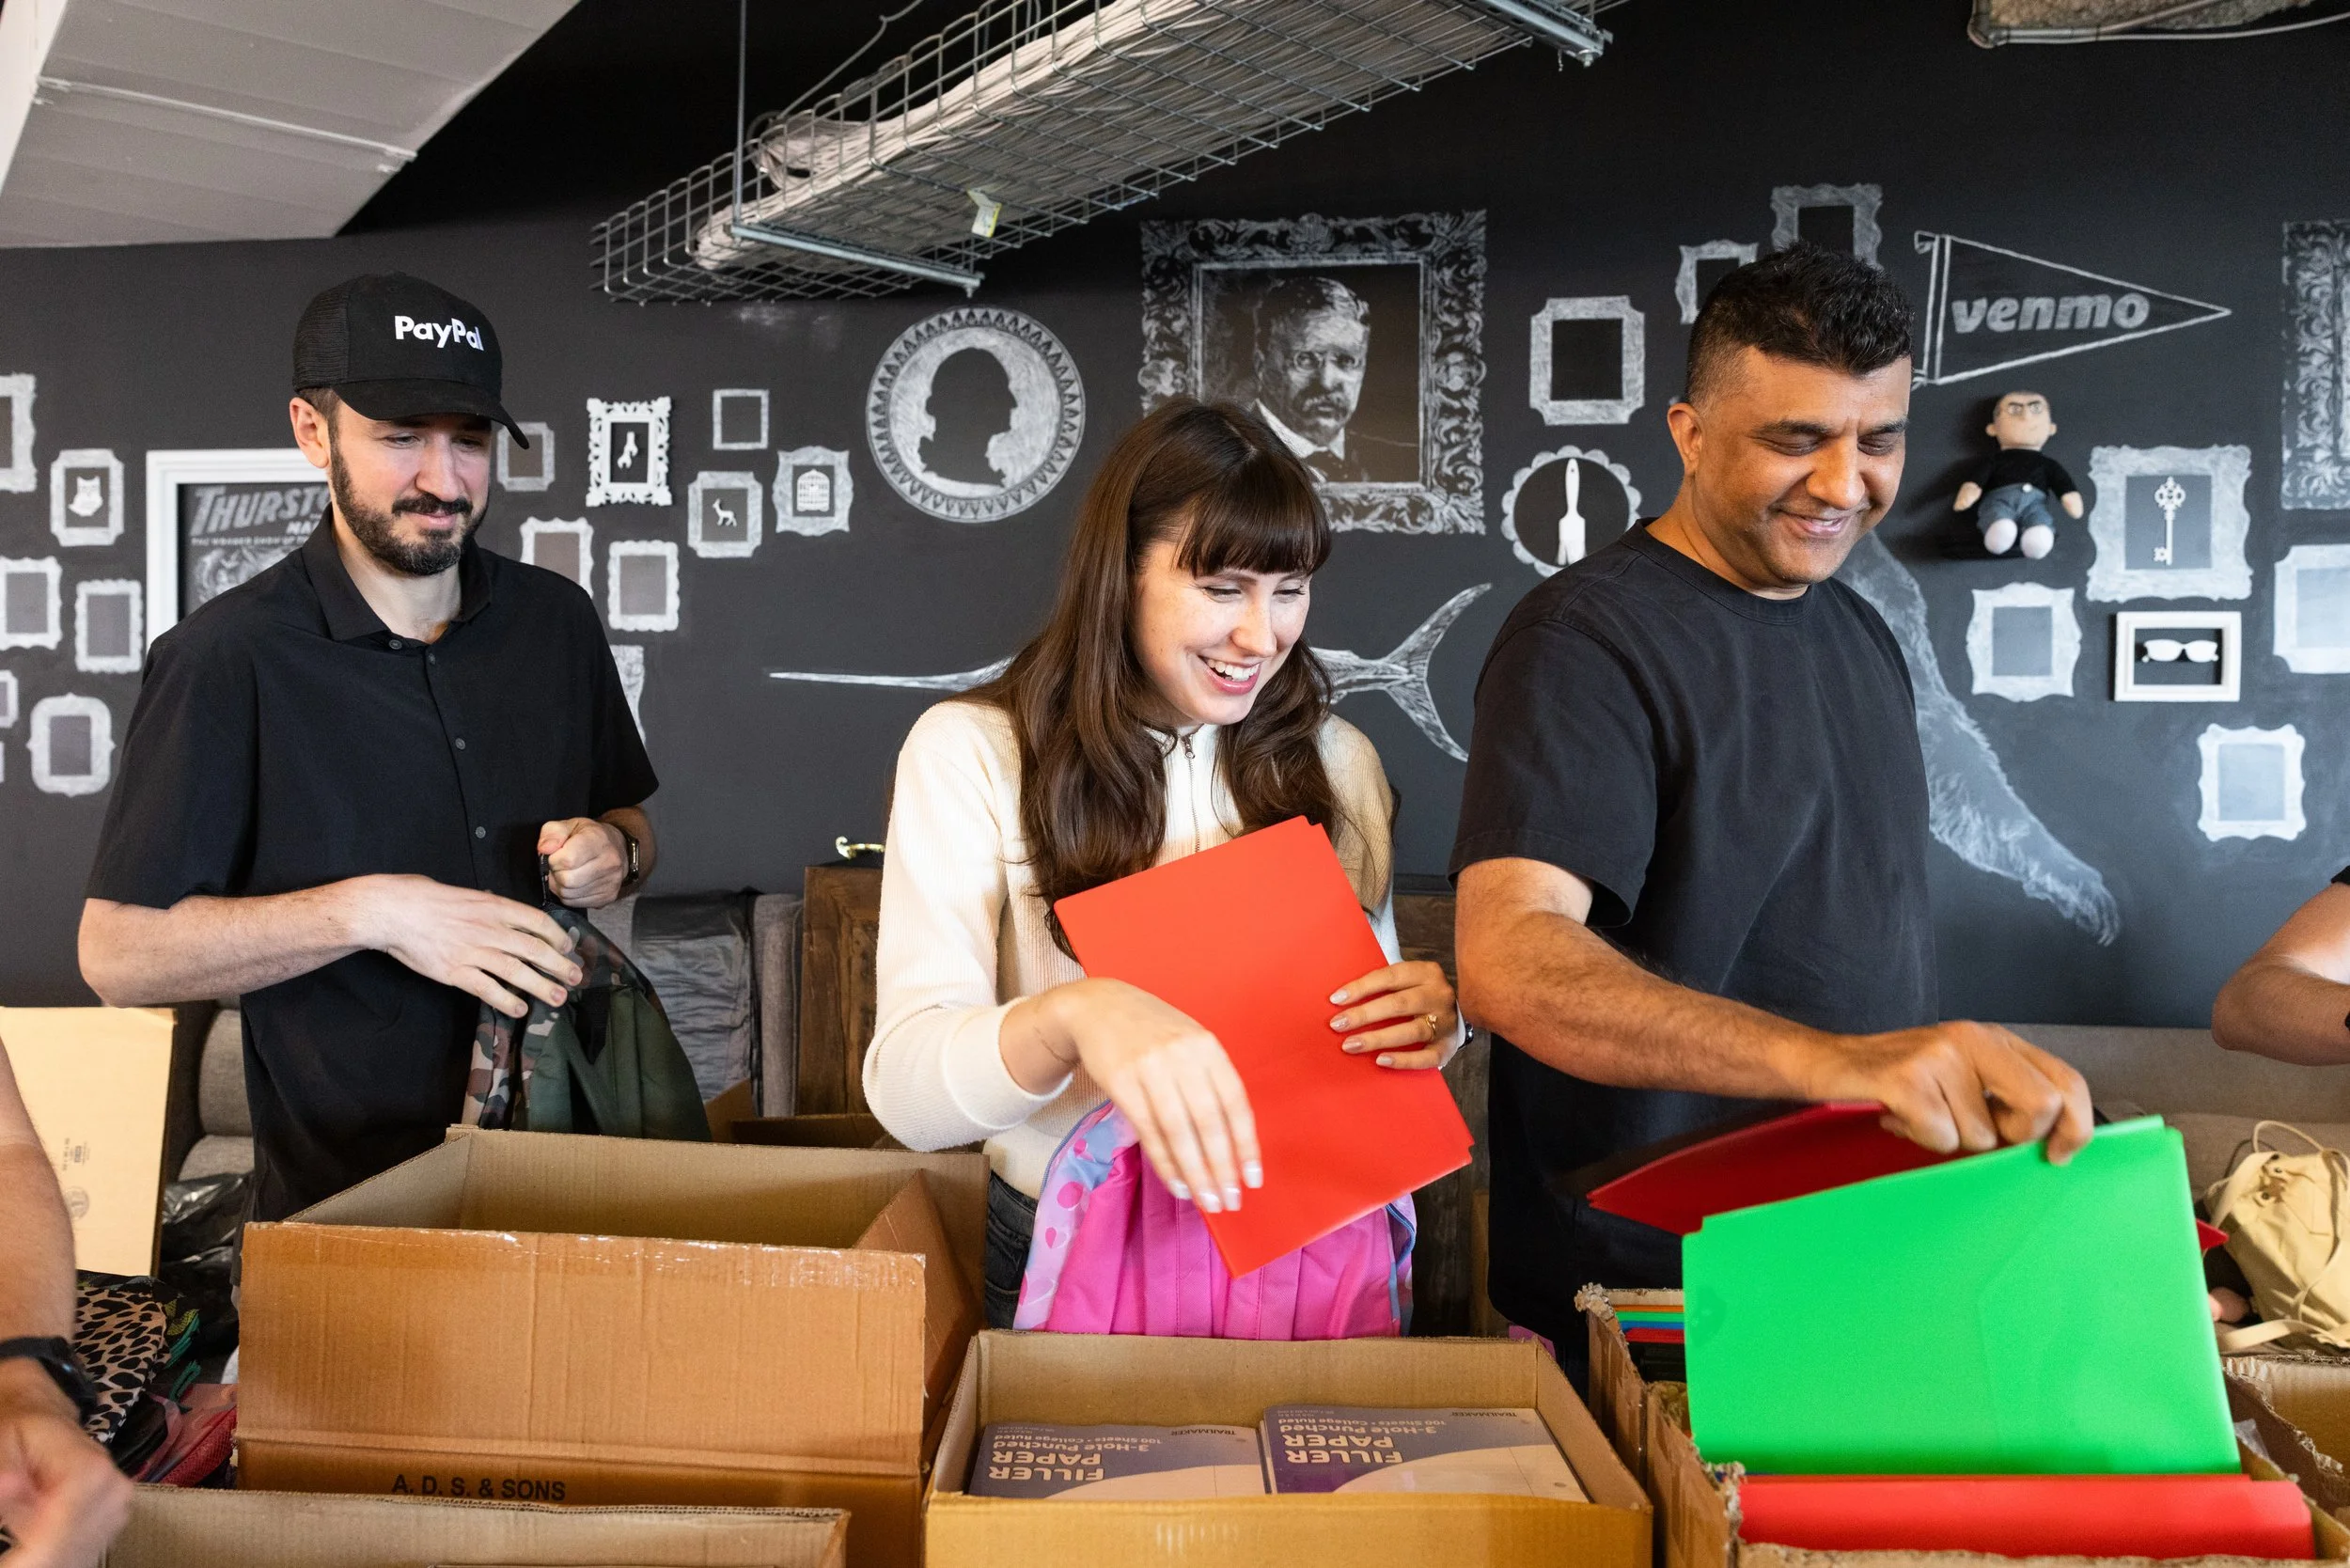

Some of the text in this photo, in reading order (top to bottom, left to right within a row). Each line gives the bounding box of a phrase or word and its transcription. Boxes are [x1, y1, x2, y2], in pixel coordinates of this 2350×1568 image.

[1951, 292, 2150, 334] venmo
[394, 315, 484, 351] PayPal
[1171, 1428, 1236, 1436] TRAILMAKER
[1279, 1424, 1437, 1435] 3-Hole Punched
[994, 1441, 1150, 1451] 3-Hole Punched
[1282, 1435, 1394, 1448] PAPER
[992, 1450, 1101, 1465] PAPER
[1285, 1450, 1402, 1464] FILLER
[988, 1466, 1104, 1481] FILLER
[392, 1474, 566, 1501] A. D. S. & SONS
